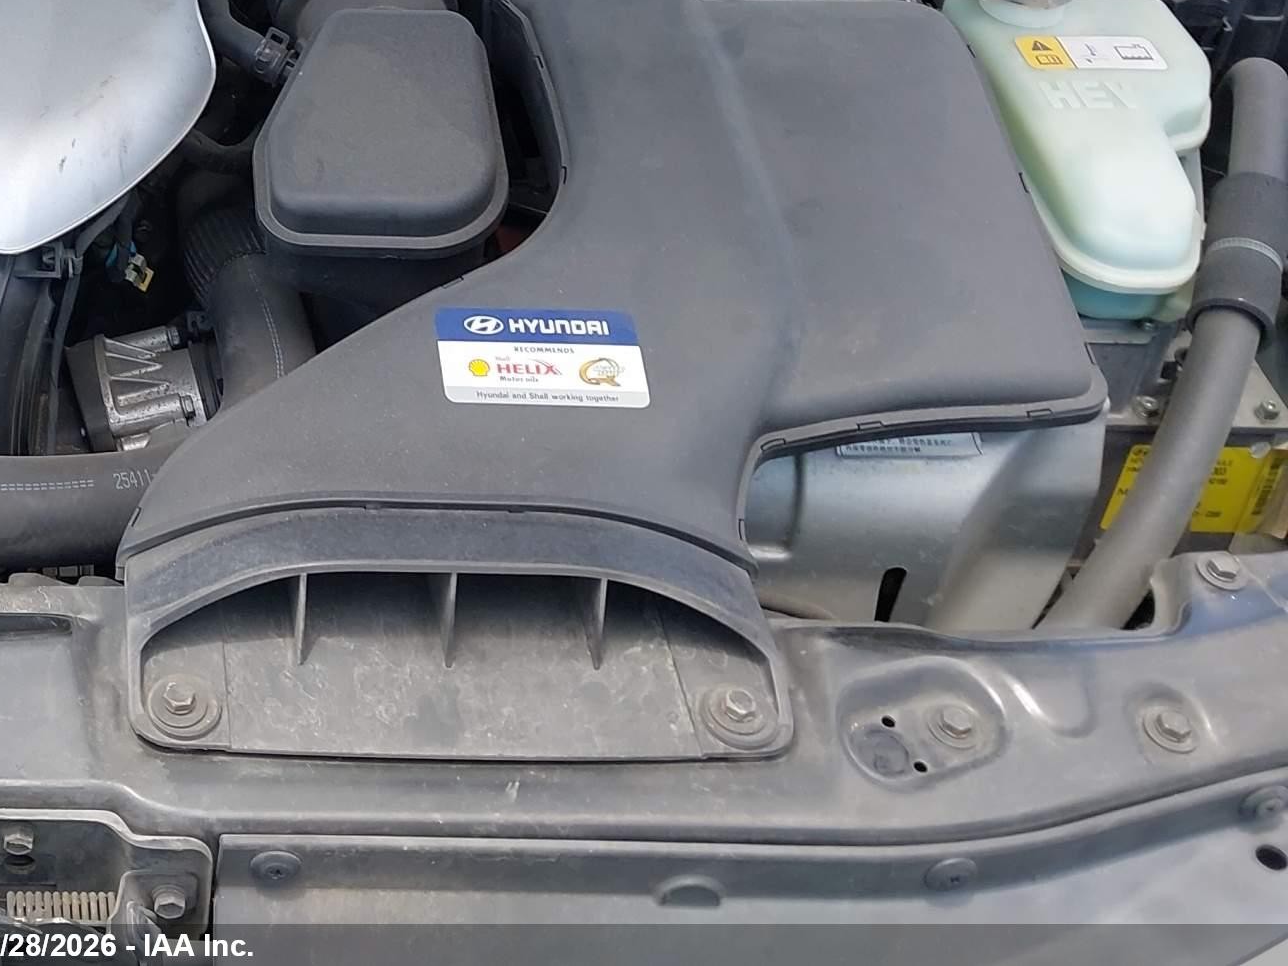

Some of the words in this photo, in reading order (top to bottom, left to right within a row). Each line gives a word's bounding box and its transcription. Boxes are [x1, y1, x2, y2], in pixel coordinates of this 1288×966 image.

[509, 318, 610, 335] HYUNDAI
[496, 363, 559, 375] HELIX
[476, 390, 509, 401] Hyundai
[112, 468, 153, 490] 25411
